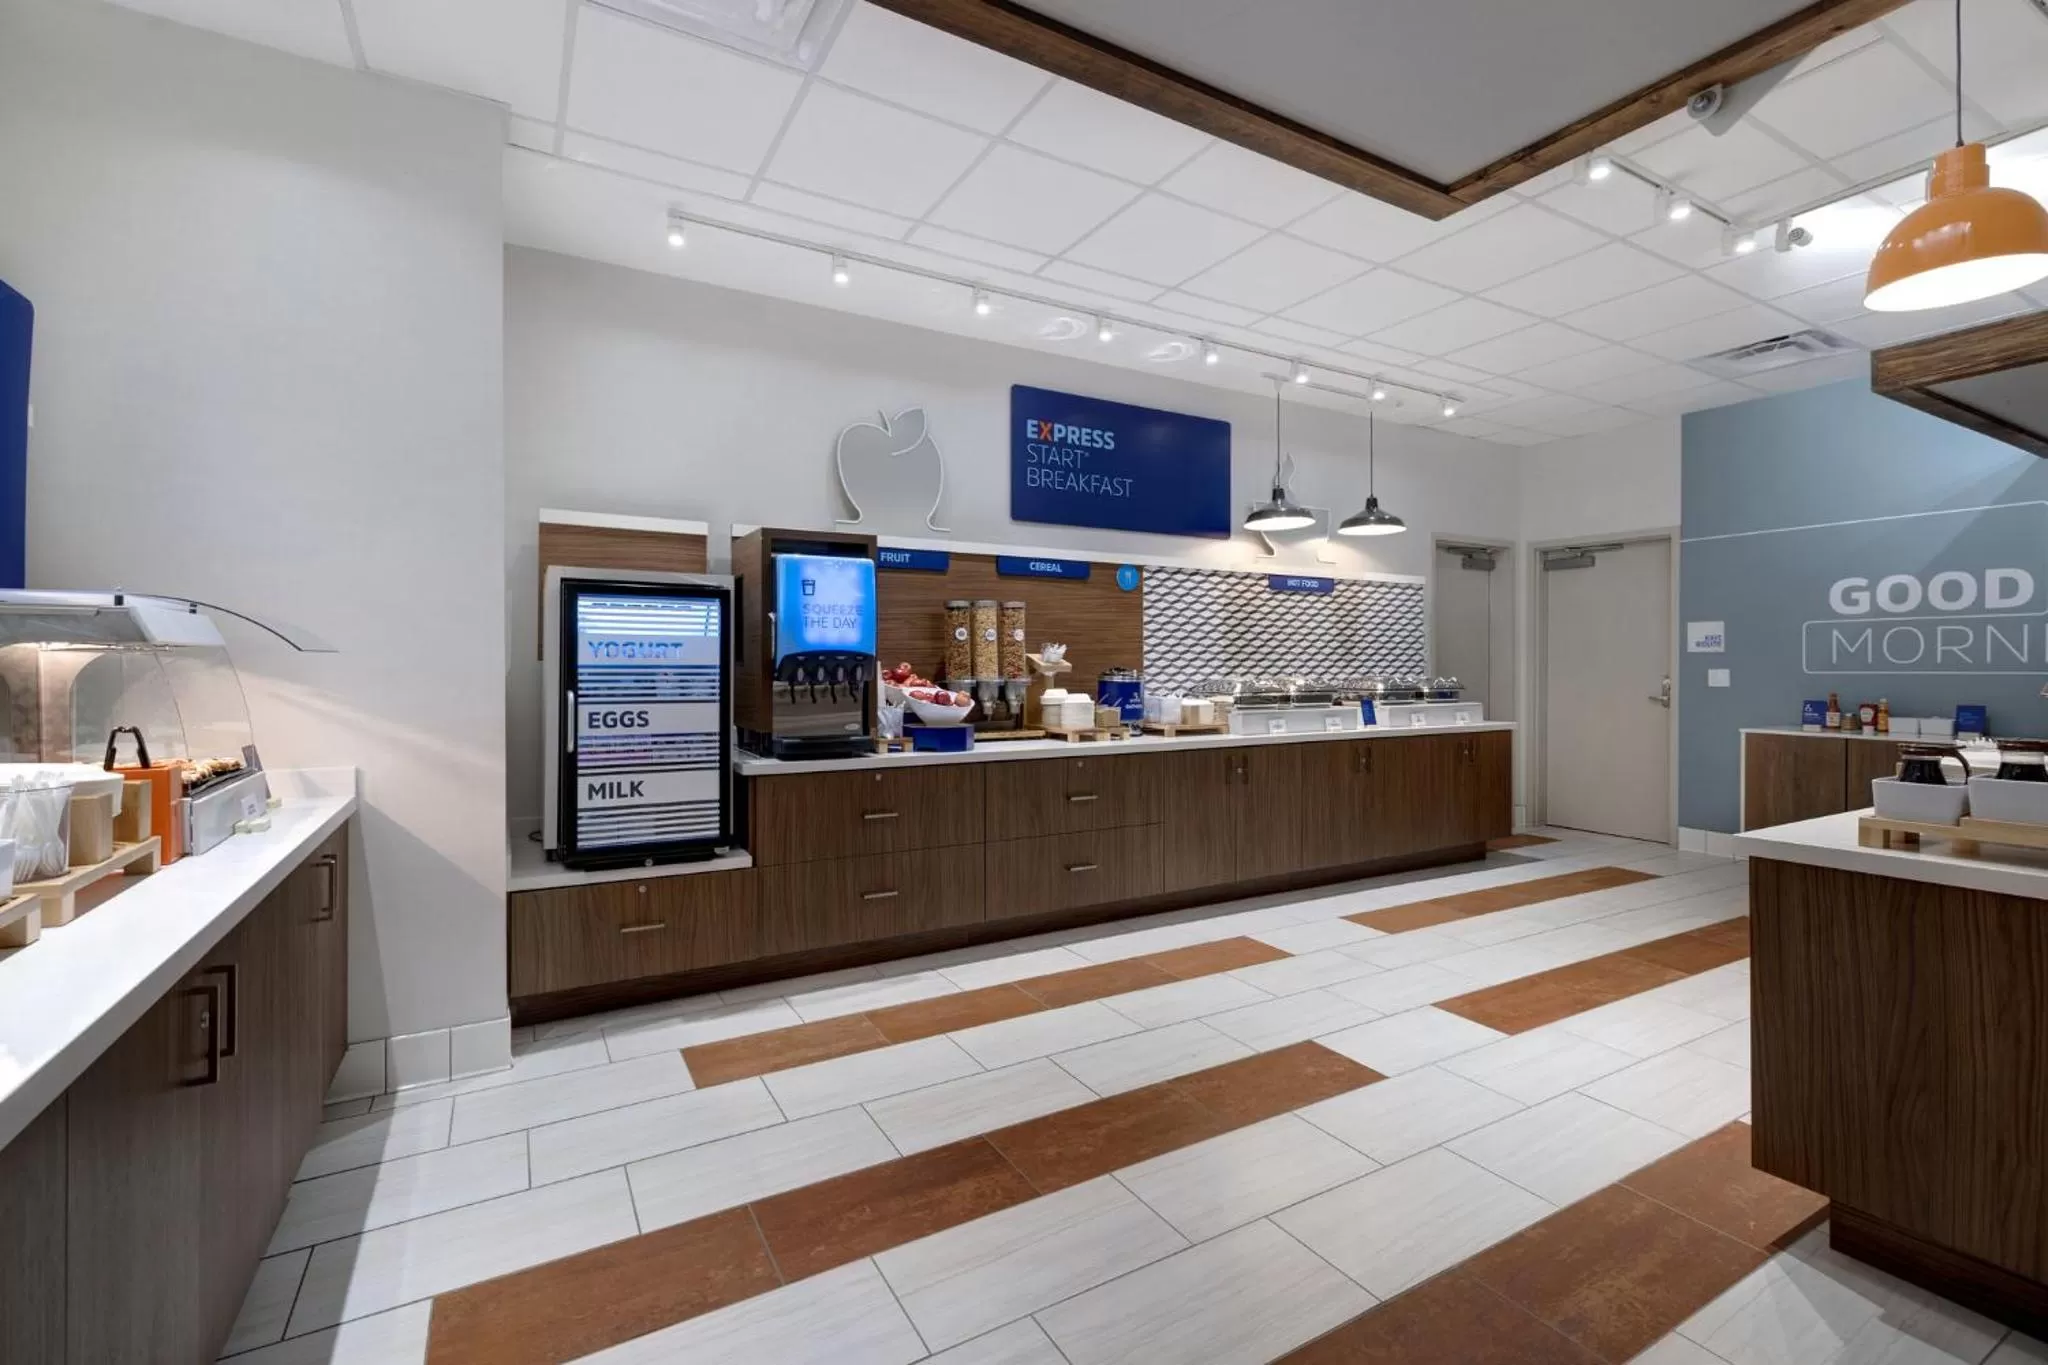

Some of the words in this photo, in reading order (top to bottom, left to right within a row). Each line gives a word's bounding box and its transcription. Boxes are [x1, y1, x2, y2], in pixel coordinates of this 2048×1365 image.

[1026, 419, 1115, 450] EXPRESS
[1027, 467, 1134, 498] BREAKFAST
[880, 551, 911, 563] FRUIT
[1029, 562, 1063, 573] CEREAL
[1829, 568, 2034, 615] GOOD
[803, 603, 865, 616] SQUEEZE
[804, 616, 829, 629] THE
[833, 617, 857, 629] DAY
[588, 641, 683, 659] YOGURT
[588, 711, 650, 729] EGGS
[588, 780, 644, 800] MILK
